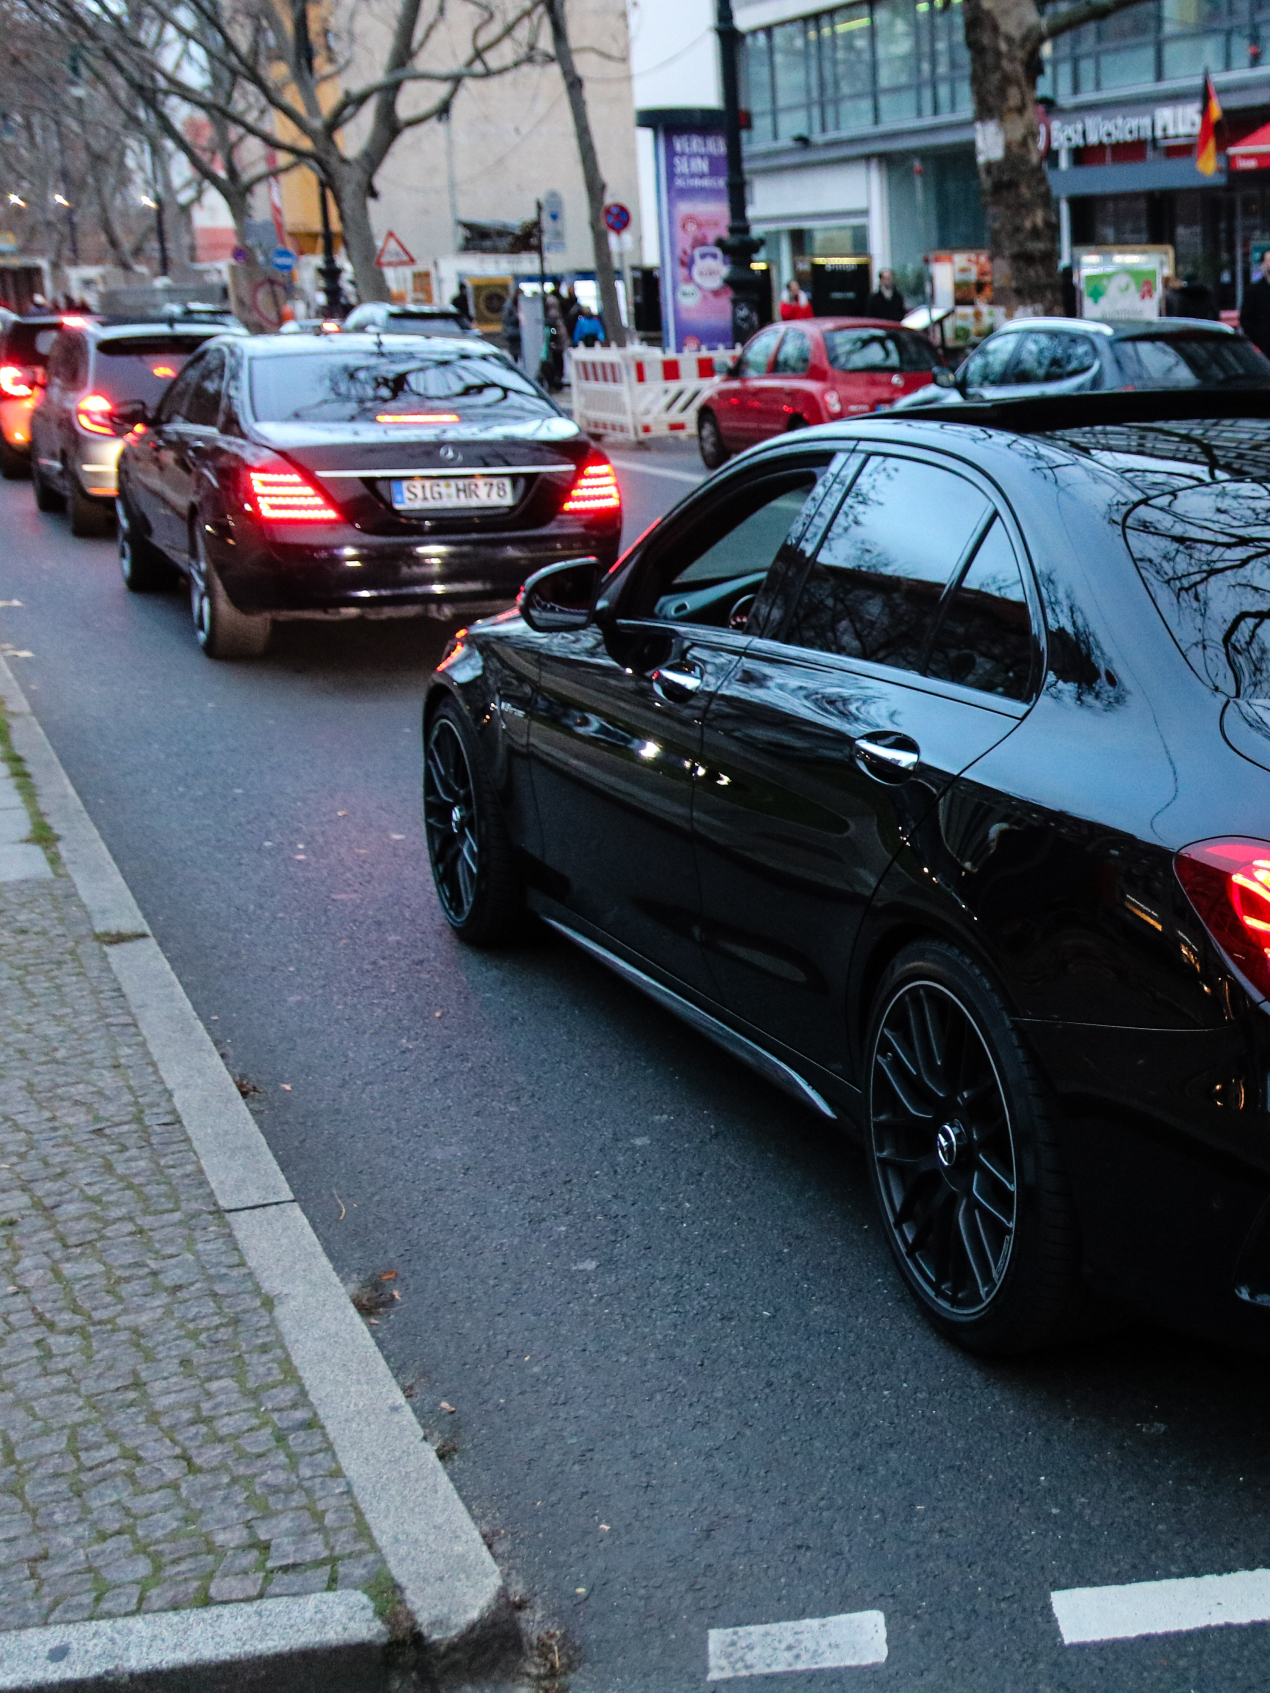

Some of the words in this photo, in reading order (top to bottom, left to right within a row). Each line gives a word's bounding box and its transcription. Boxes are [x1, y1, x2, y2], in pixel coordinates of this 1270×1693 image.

[1050, 119, 1084, 150] Best
[1084, 115, 1151, 146] Western
[1153, 103, 1200, 138] PLUS
[673, 155, 709, 175] SEIN
[406, 482, 442, 501] SIG
[455, 482, 480, 499] HR
[484, 480, 507, 498] 78
